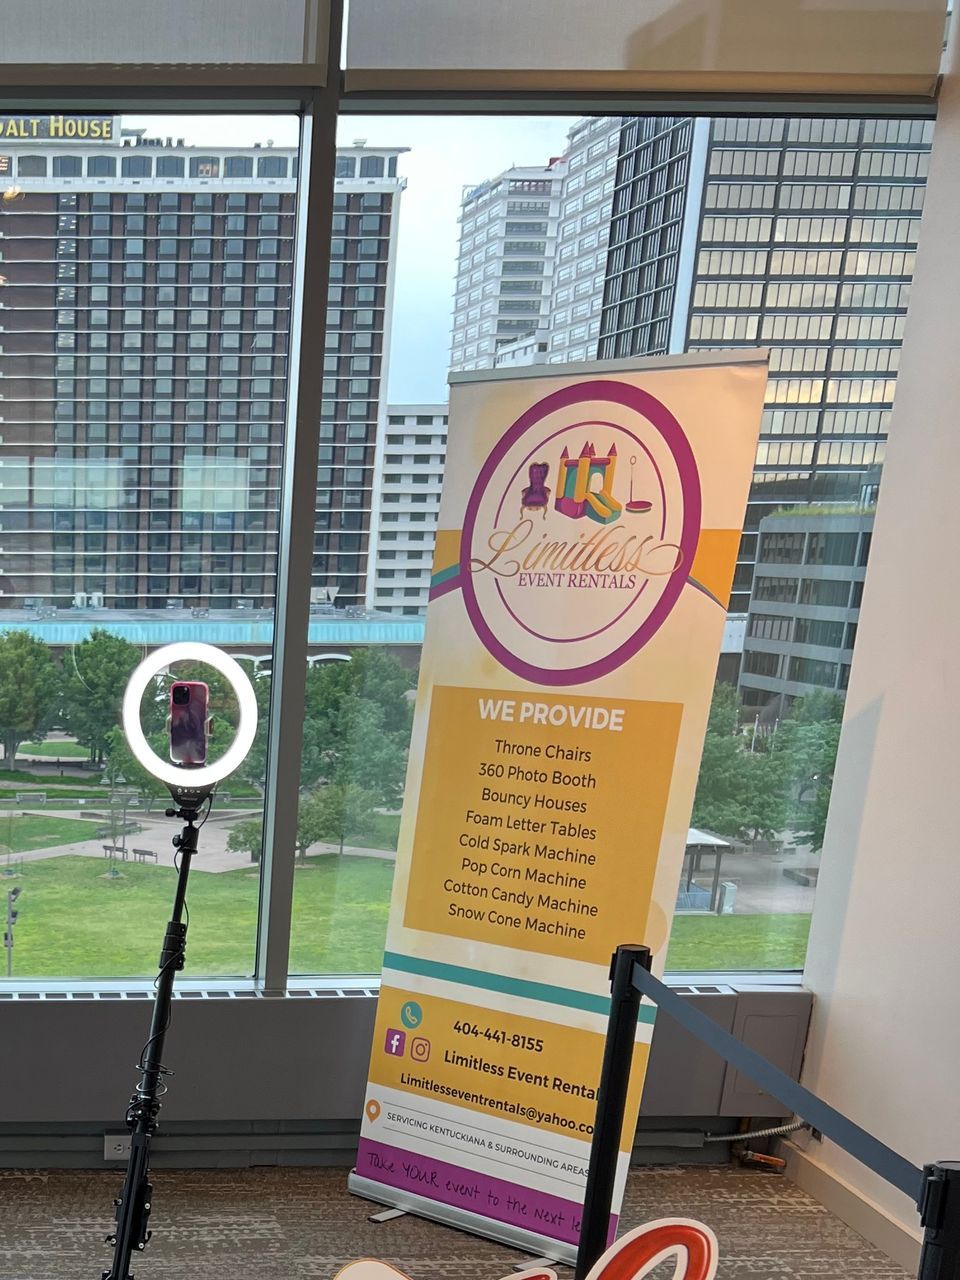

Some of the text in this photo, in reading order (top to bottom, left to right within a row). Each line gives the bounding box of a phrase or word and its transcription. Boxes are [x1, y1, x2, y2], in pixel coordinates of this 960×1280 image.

[49, 115, 112, 138] HOUSE
[468, 519, 684, 578] Limitless
[518, 572, 636, 590] EVENT RENTALS
[478, 699, 625, 731] WE PROVIDE
[495, 739, 592, 763] Throne Chairs
[478, 763, 596, 789] 360 Photo Booth
[481, 788, 587, 813] Bouncy Houses
[465, 810, 596, 840] Foam Letter Tables
[459, 834, 596, 866] Cold Spark Machine
[461, 858, 587, 889] Pop Corn Machine
[443, 879, 598, 917] Cotton Candy Machine
[448, 903, 586, 940] Snow Cone Machine
[453, 1020, 544, 1053] 404-441-8155
[444, 1050, 600, 1101] Limitless Event Rental
[400, 1073, 594, 1135] Limitlesseventrentals@yahoo.co
[387, 1112, 590, 1178] SERVICING KENTUCKIANA & SURROUNDING AREAS
[367, 1152, 395, 1173] Take
[402, 1163, 439, 1188] YOUR
[488, 1189, 500, 1206] to
[507, 1195, 527, 1215] the
